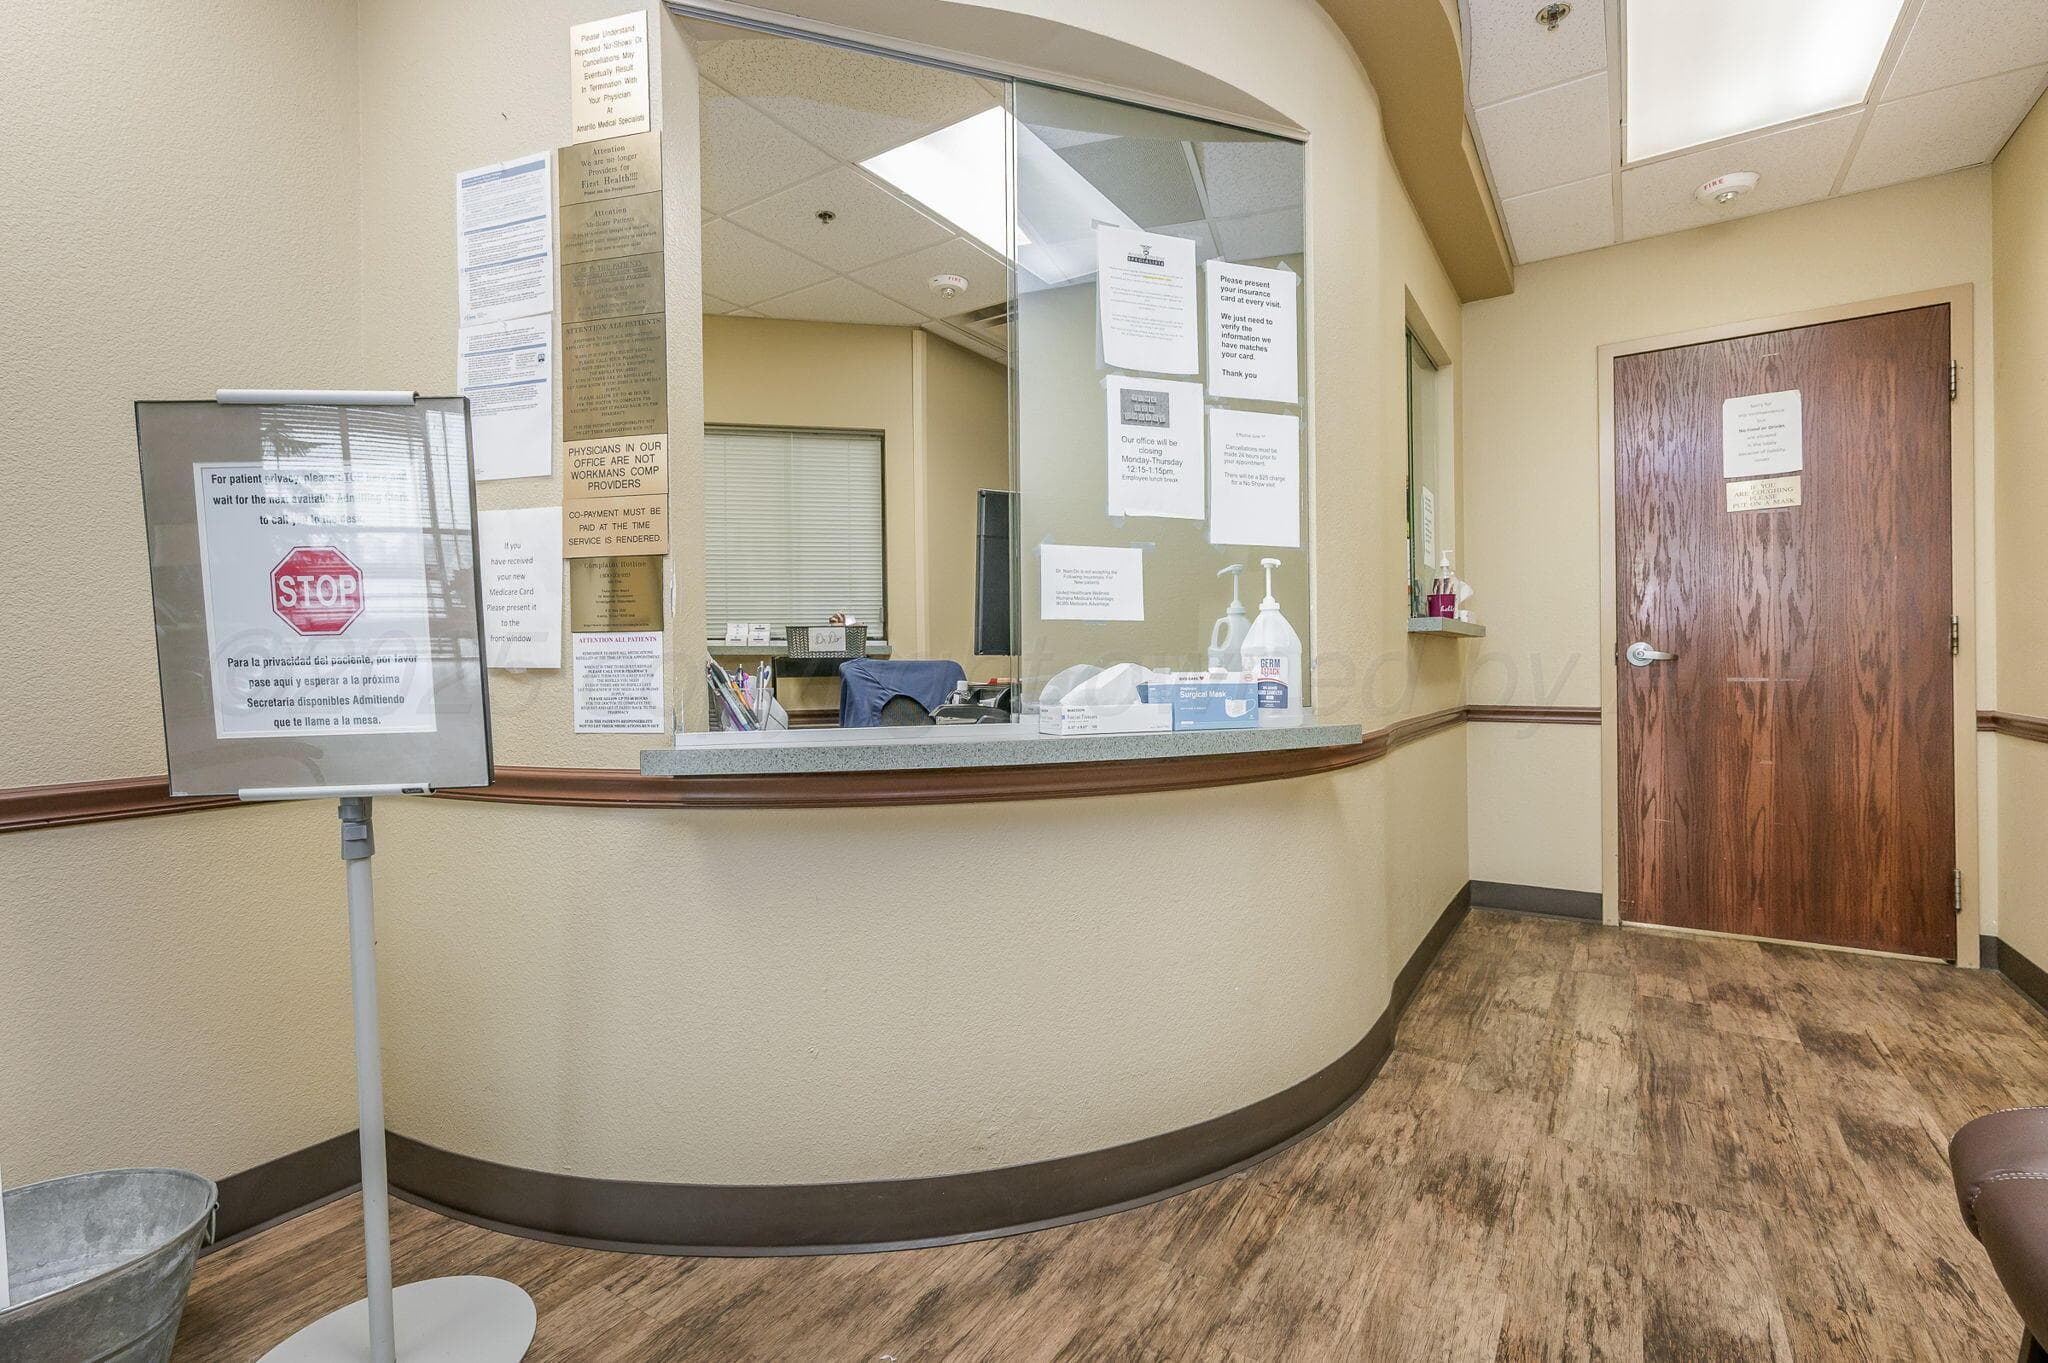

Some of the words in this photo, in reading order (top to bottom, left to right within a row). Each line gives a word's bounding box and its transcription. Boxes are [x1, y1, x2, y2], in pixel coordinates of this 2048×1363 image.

[581, 34, 600, 42] Please
[602, 25, 635, 38] Understand
[574, 46, 601, 57] Repeated
[635, 36, 641, 44] Or
[583, 55, 619, 68] Cancellations
[622, 52, 634, 60] May
[584, 67, 612, 80] Eventually
[616, 64, 633, 73] Result
[590, 81, 622, 91] Termination
[604, 91, 631, 102] Physician
[577, 123, 596, 133] Amarillo
[598, 120, 616, 129] Medical
[619, 114, 644, 125] Specialists
[593, 145, 625, 156] Attention
[588, 167, 617, 176] Providers
[581, 180, 599, 188] First
[1704, 179, 1723, 190] FIRE
[594, 207, 626, 217] Attention
[1221, 275, 1242, 285] Please
[1245, 280, 1270, 288] present
[1221, 286, 1236, 295] your
[1238, 288, 1270, 297] insurance
[1246, 298, 1264, 307] every
[1233, 315, 1246, 323] just
[566, 323, 607, 334] ATTENTION
[609, 321, 623, 329] ALL
[625, 319, 661, 327] PATIENTS
[1221, 323, 1239, 331] verify
[1222, 332, 1260, 342] information
[1240, 344, 1268, 352] matches
[1222, 369, 1242, 377] Thank
[1136, 437, 1155, 445] office
[568, 444, 620, 456] PHYSICIANS
[626, 444, 634, 452] IN
[640, 442, 661, 451] OUR
[1139, 447, 1162, 456] closing
[574, 457, 605, 468] OFFICE
[611, 456, 629, 465] ARE
[635, 454, 655, 463] NOT
[1122, 455, 1183, 467] Monday-Thursday
[571, 468, 625, 480] WORKMANS
[631, 466, 659, 476] COMP
[211, 474, 226, 484] For
[230, 474, 262, 485] patient
[588, 479, 641, 491] PROVIDERS
[213, 495, 233, 504] wait
[236, 494, 249, 504] for
[251, 494, 266, 504] the
[569, 509, 619, 519] CO-PAYMENT
[624, 508, 645, 516] MUST
[650, 507, 661, 515] BE
[260, 515, 268, 525] to
[612, 522, 628, 530] THE
[632, 521, 650, 529] TIME
[569, 537, 601, 545] SERVICE
[616, 535, 662, 543] RENDERED.
[510, 543, 521, 551] you
[508, 556, 533, 565] received
[585, 562, 617, 570] Complaint
[497, 574, 511, 582] your
[278, 575, 357, 607] STOP
[487, 604, 504, 612] Please
[506, 605, 530, 614] present
[227, 658, 249, 668] Para
[251, 657, 260, 667] la
[263, 656, 311, 669] privacidad
[314, 655, 328, 666] del
[331, 654, 374, 667] paciente,
[1261, 659, 1280, 667] GERM
[249, 678, 270, 689] pase
[296, 678, 301, 688] y
[304, 676, 339, 688] esperar
[343, 677, 348, 685] a
[351, 675, 359, 685] la
[362, 674, 400, 686] próxima
[1180, 688, 1207, 699] Surgical
[1209, 689, 1226, 698] Mask
[247, 698, 295, 708] Secretaria
[297, 695, 350, 708] disponibles
[353, 694, 404, 706] Admitiendo
[274, 718, 290, 728] que
[293, 717, 302, 727] te
[304, 716, 330, 726] llame
[342, 715, 350, 725] la
[353, 716, 381, 725] mesa.
